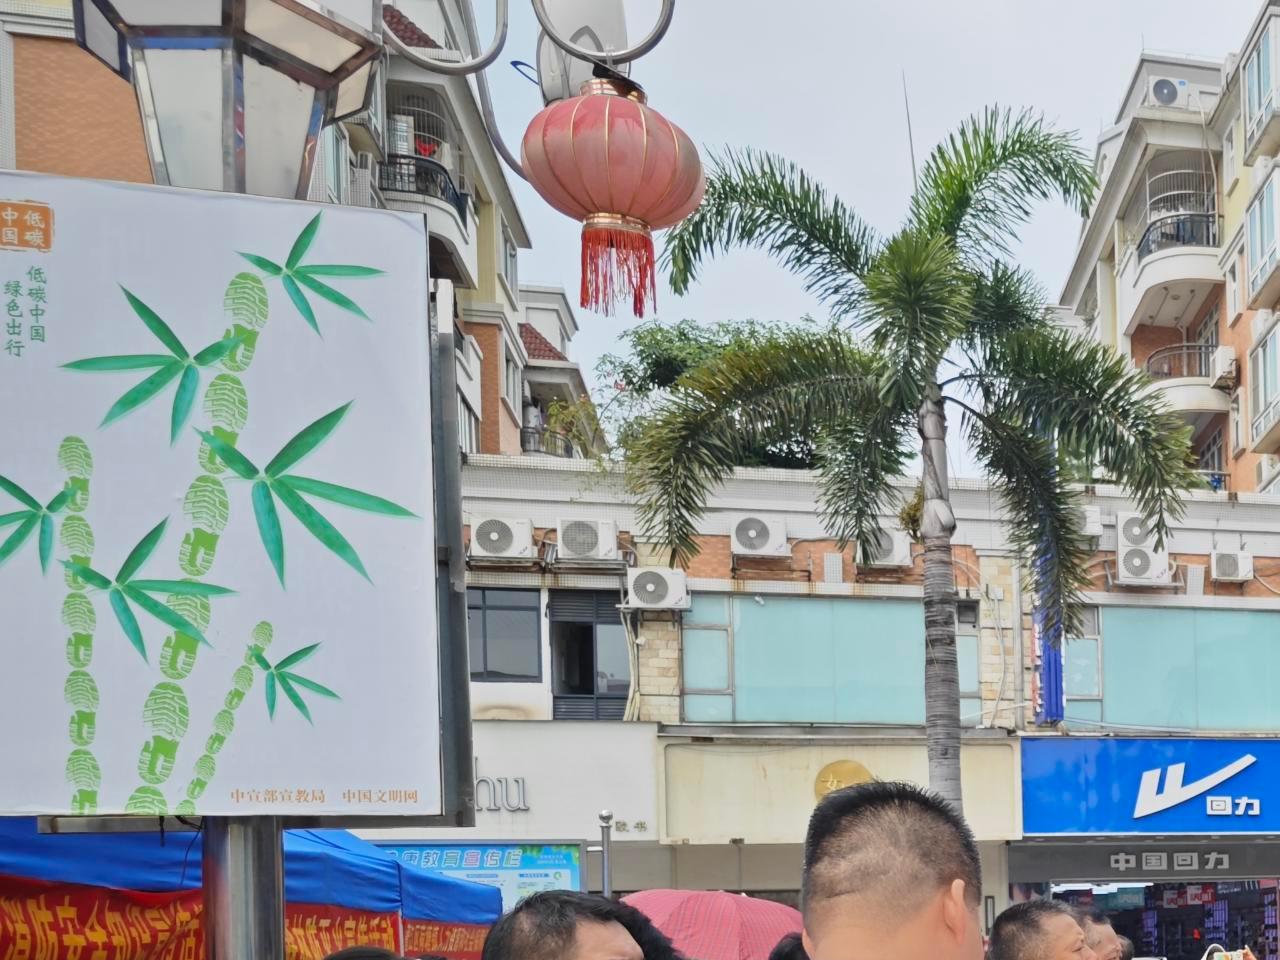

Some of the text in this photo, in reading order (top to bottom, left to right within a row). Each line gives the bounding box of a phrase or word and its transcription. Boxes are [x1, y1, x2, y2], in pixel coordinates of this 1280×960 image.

[1, 207, 19, 246] 中国
[24, 210, 46, 247] 低碳
[4, 280, 25, 357] 绿色出行
[26, 265, 47, 343] 低碳中国
[231, 789, 419, 803] 中宣部宣教局 中国文明网
[1206, 796, 1260, 816] 回力
[1110, 852, 1230, 871] 中国回力
